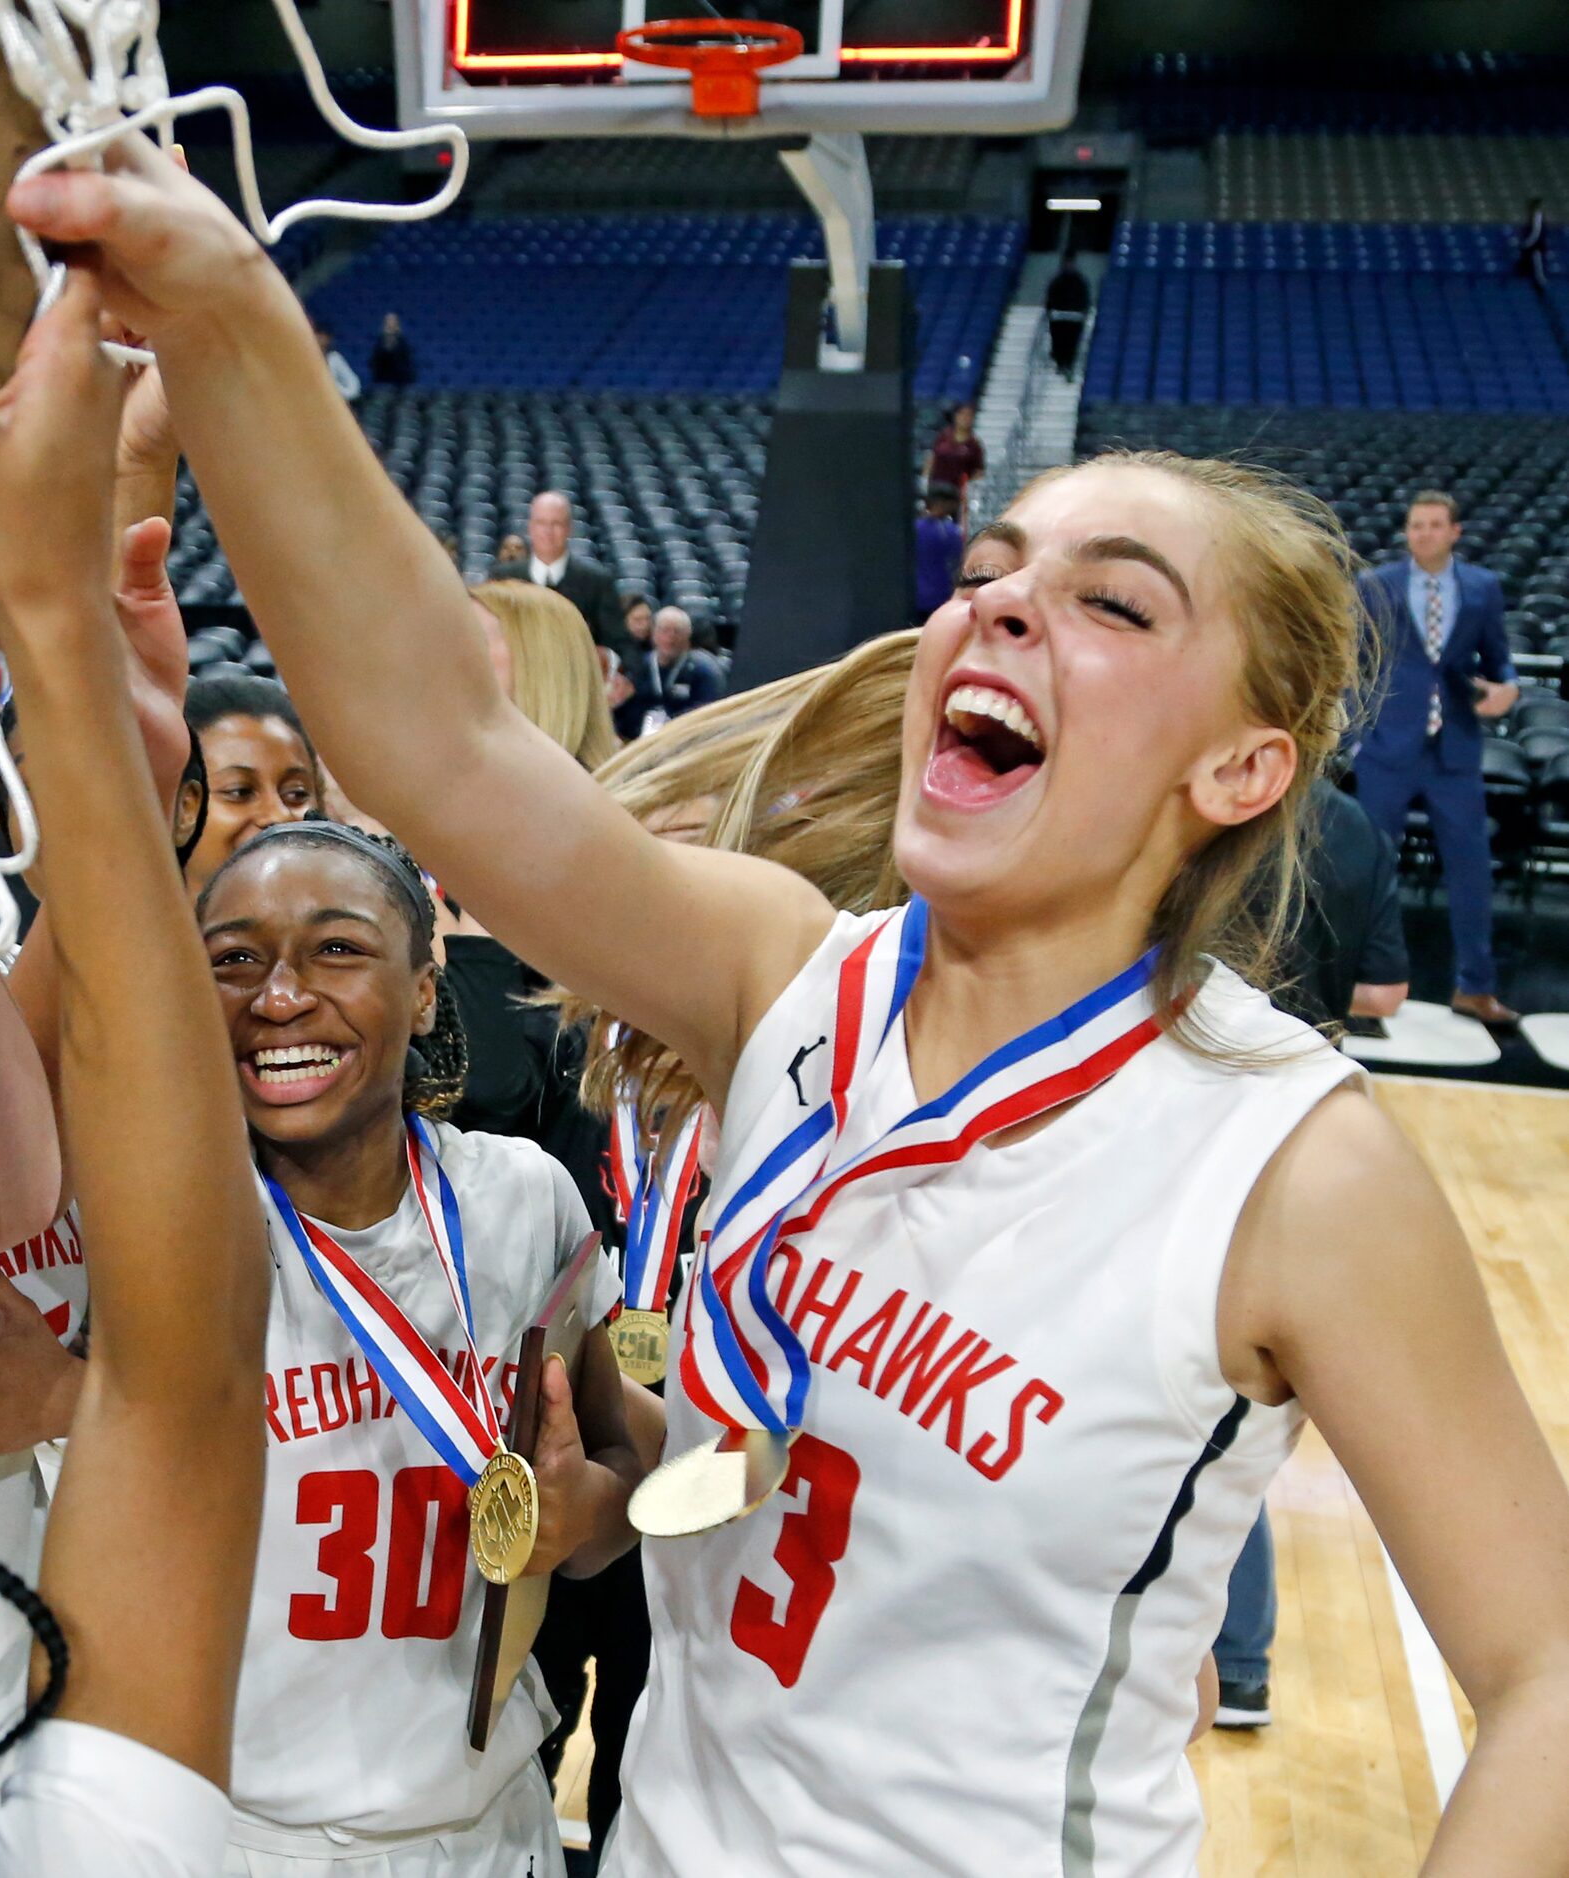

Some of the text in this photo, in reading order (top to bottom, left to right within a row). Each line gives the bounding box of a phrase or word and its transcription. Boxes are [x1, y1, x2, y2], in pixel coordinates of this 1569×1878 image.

[685, 1230, 1065, 1482] DHAWKS
[288, 1465, 471, 1641] 30
[730, 1431, 861, 1689] 3
